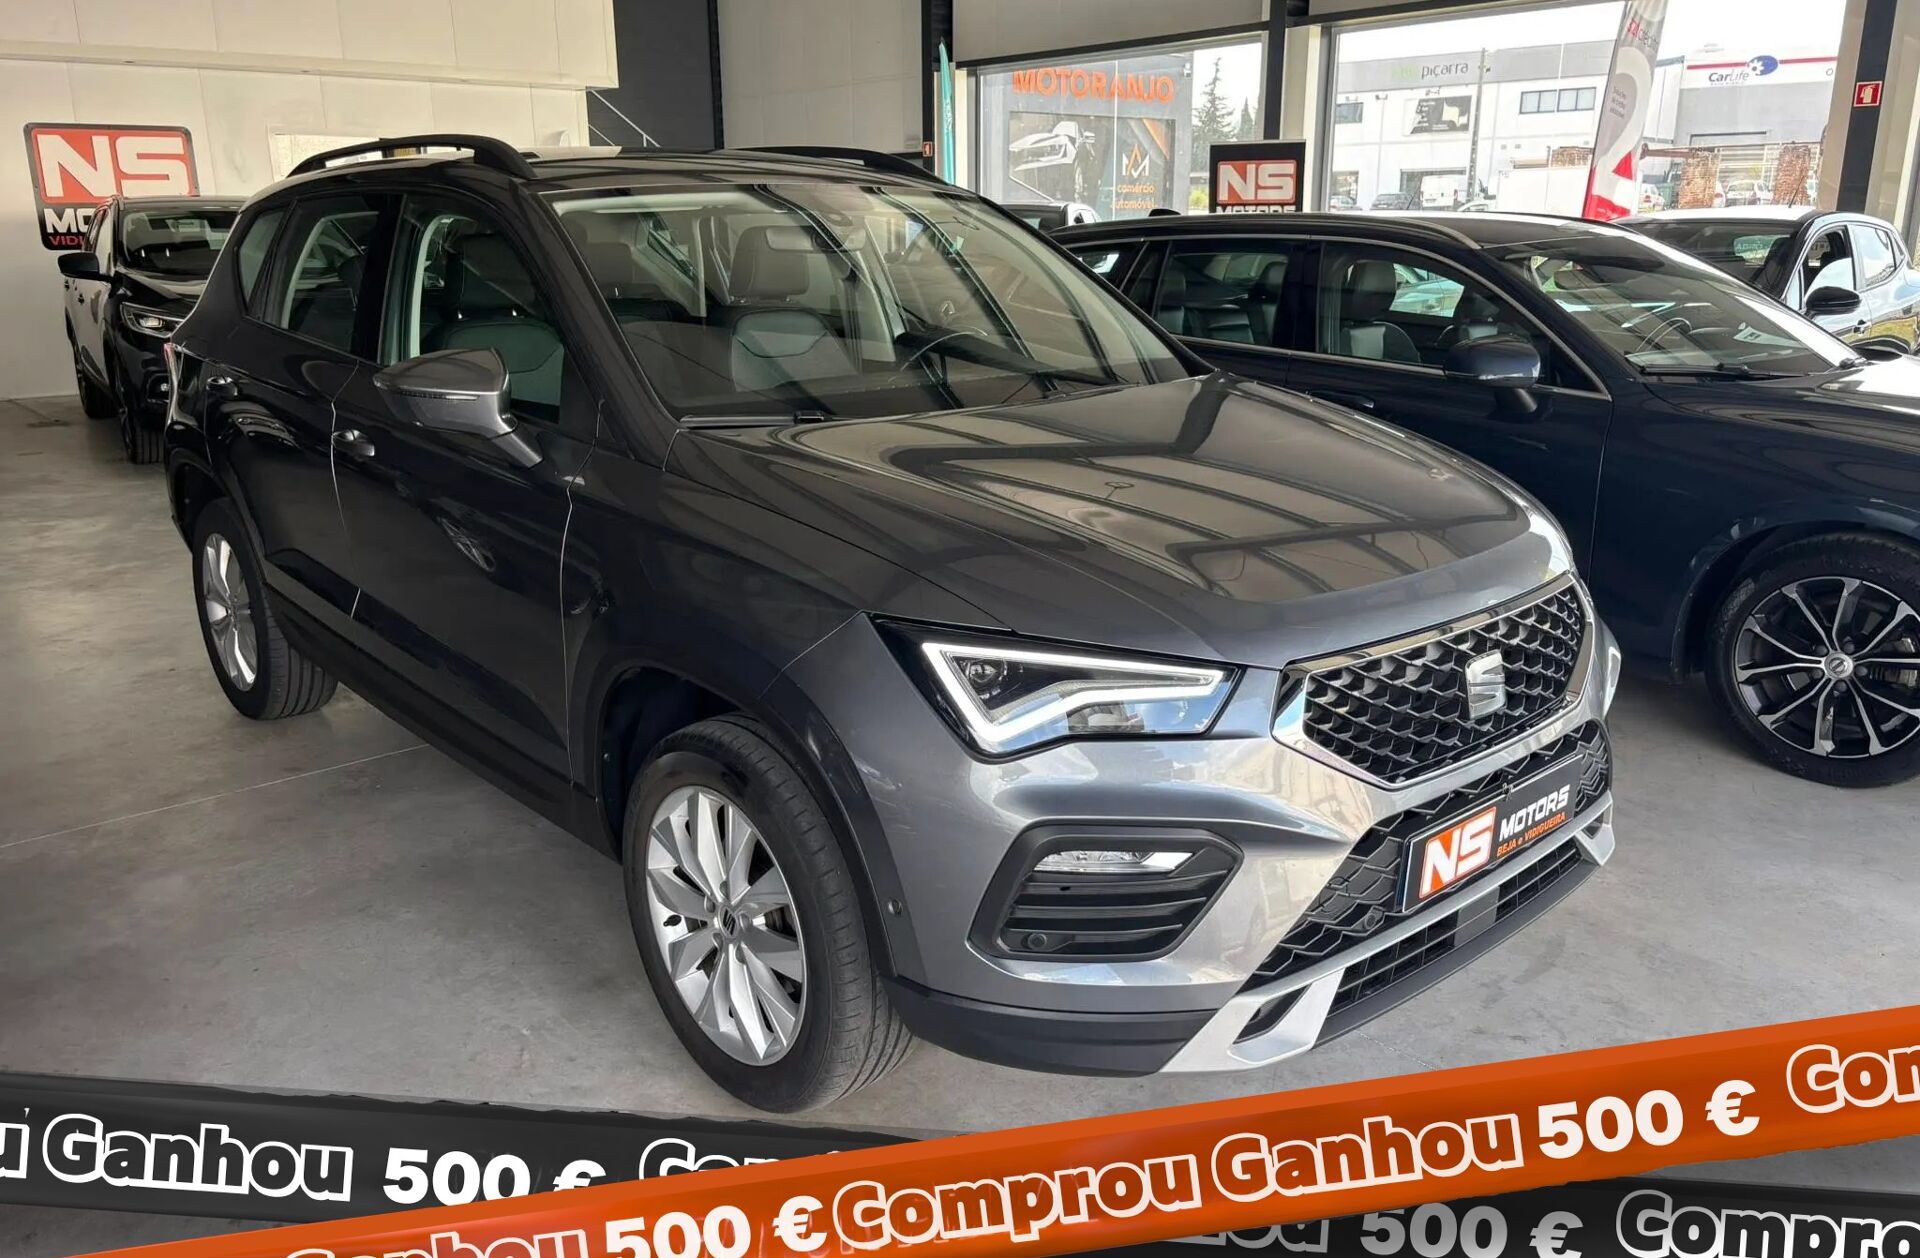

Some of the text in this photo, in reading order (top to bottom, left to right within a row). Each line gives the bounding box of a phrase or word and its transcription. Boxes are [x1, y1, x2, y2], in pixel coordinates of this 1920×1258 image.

[1012, 68, 1174, 103] MOTORANJO
[1420, 62, 1469, 80] piçarra
[37, 134, 190, 198] NS
[1219, 163, 1295, 201] NS
[1497, 838, 1517, 857] BEJA
[1524, 811, 1566, 841] VIDIGUEIRA
[1499, 784, 1570, 842] MOTORS
[1421, 809, 1495, 898] NS
